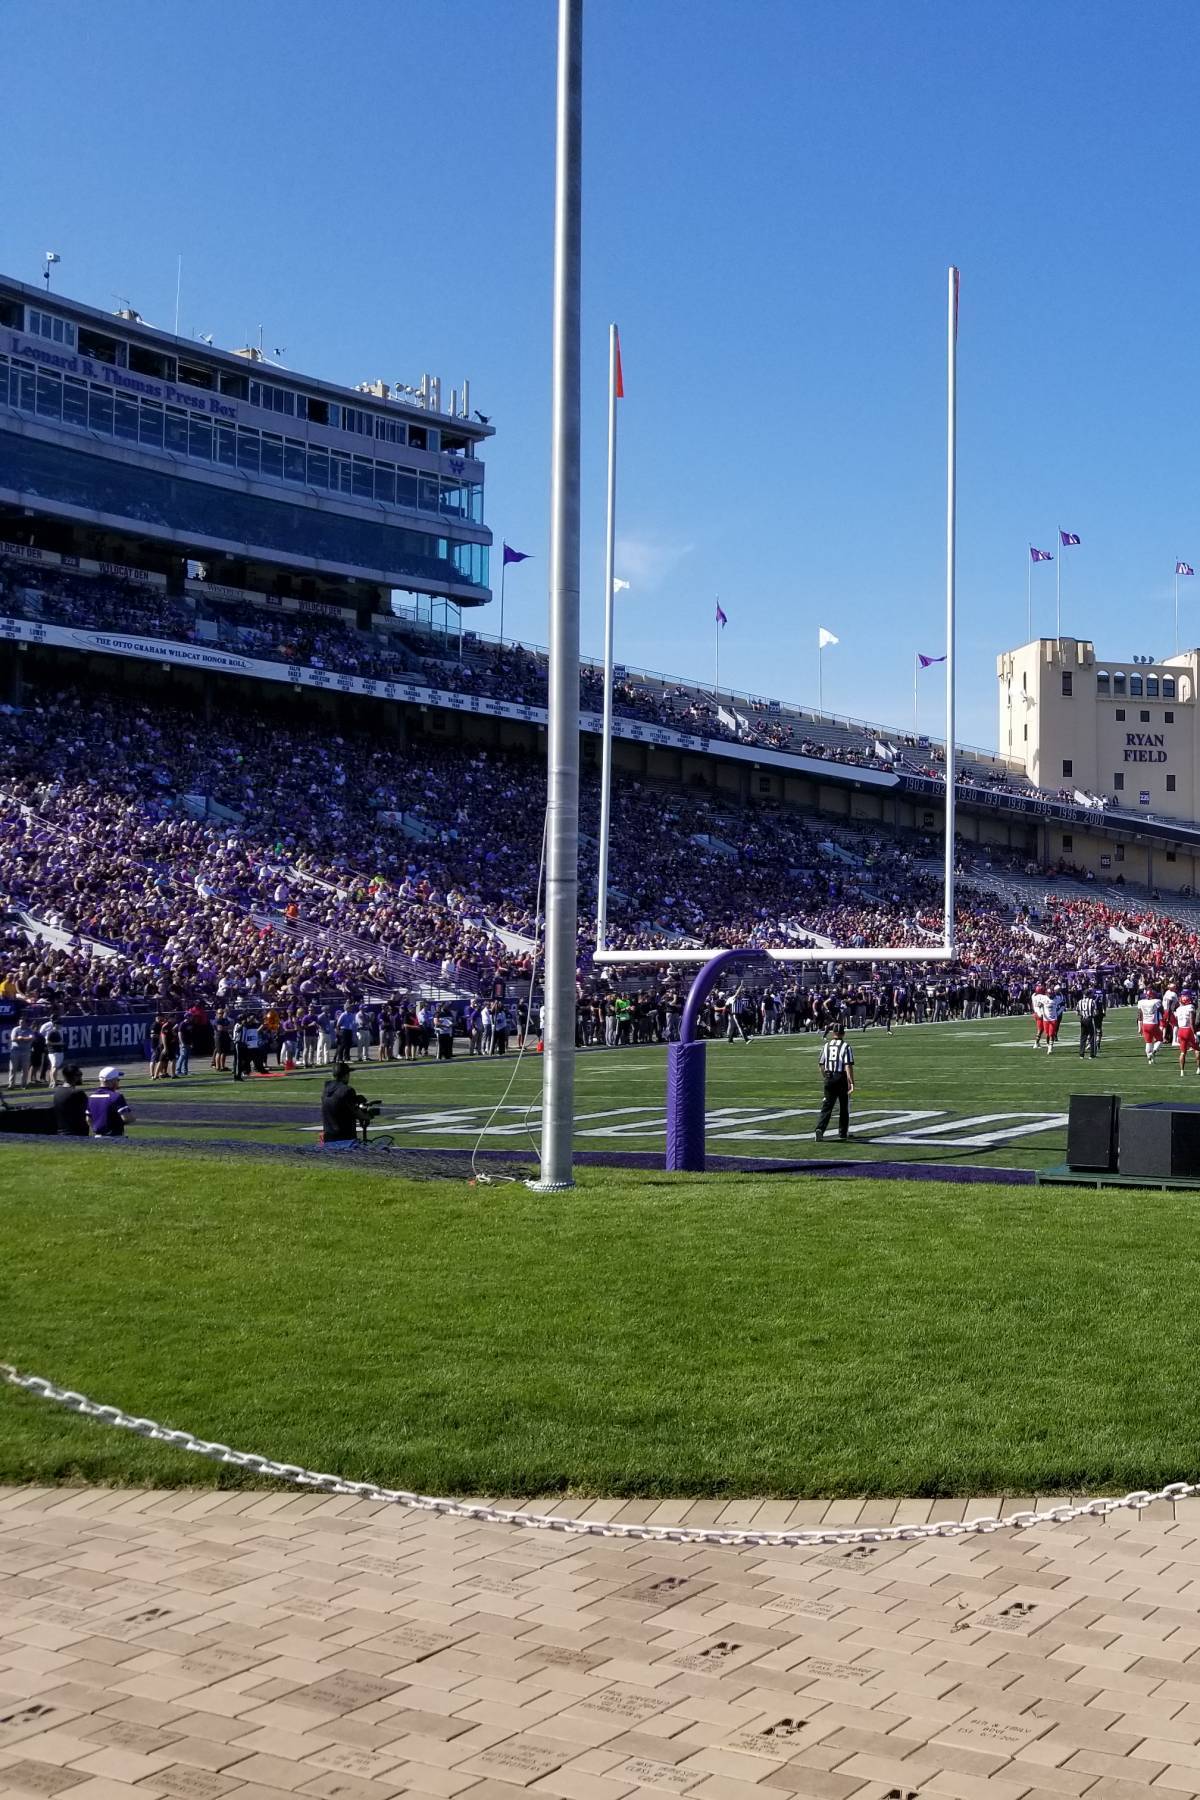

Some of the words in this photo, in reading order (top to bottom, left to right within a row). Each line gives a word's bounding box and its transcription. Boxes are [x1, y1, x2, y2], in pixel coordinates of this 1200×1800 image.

[12, 337, 80, 373] Leonard
[82, 359, 98, 379] B.
[101, 366, 161, 396] Thomas
[164, 384, 206, 410] Press
[209, 398, 237, 419] Box
[134, 570, 148, 581] DEN
[96, 637, 111, 646] THE
[112, 640, 132, 649] OTTO
[134, 643, 166, 655] GRAHAM
[168, 649, 200, 660] WILDCAT
[202, 654, 226, 665] HONOR
[228, 659, 246, 668] ROLL
[1126, 733, 1164, 746] RYAN
[1123, 750, 1168, 762] FIELD
[906, 778, 925, 792] 1903
[958, 787, 977, 801] 1930
[984, 792, 1002, 805] 1931
[1008, 796, 1026, 811] 1936
[1034, 802, 1052, 816] 1995
[1058, 806, 1078, 820] 1996
[1084, 810, 1106, 826] 2000
[98, 1023, 148, 1047] TEAM
